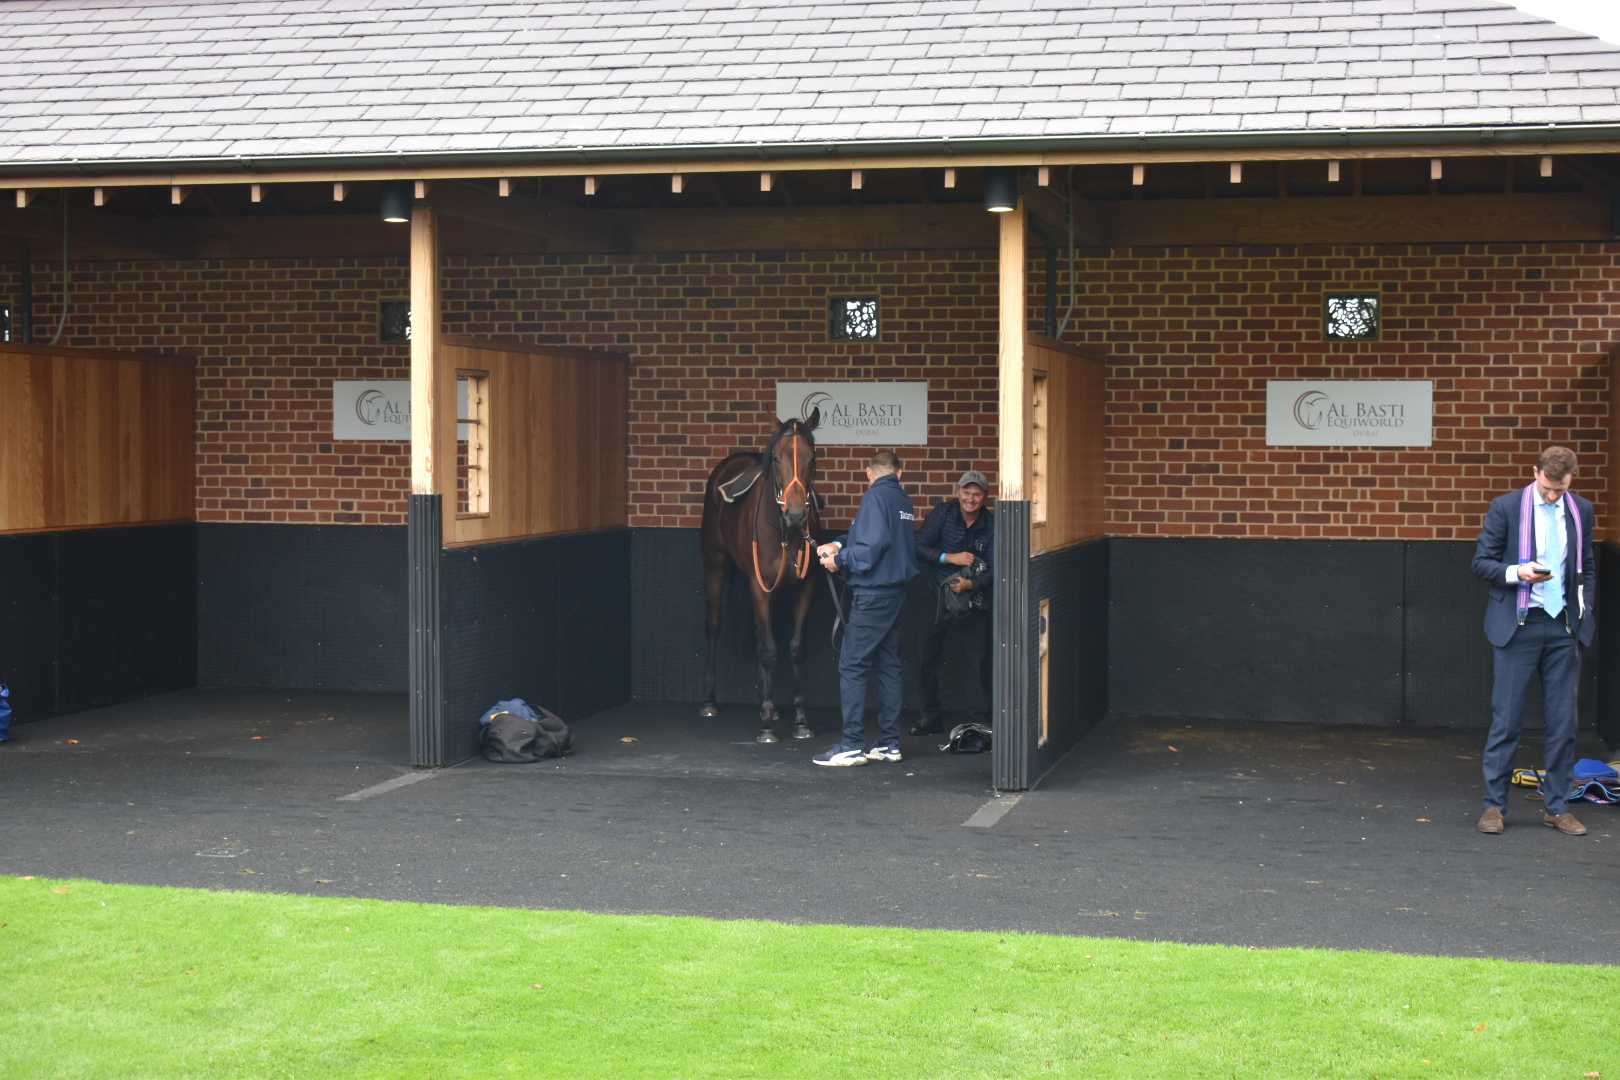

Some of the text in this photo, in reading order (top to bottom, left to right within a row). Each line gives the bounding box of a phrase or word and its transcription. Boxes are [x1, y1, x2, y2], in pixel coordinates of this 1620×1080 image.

[383, 401, 402, 414] AL
[832, 403, 902, 417] AL BASTI
[1327, 403, 1404, 417] AL BASTI
[832, 417, 902, 428] EQUIWORLD
[1327, 417, 1404, 429] EQUIWORLD
